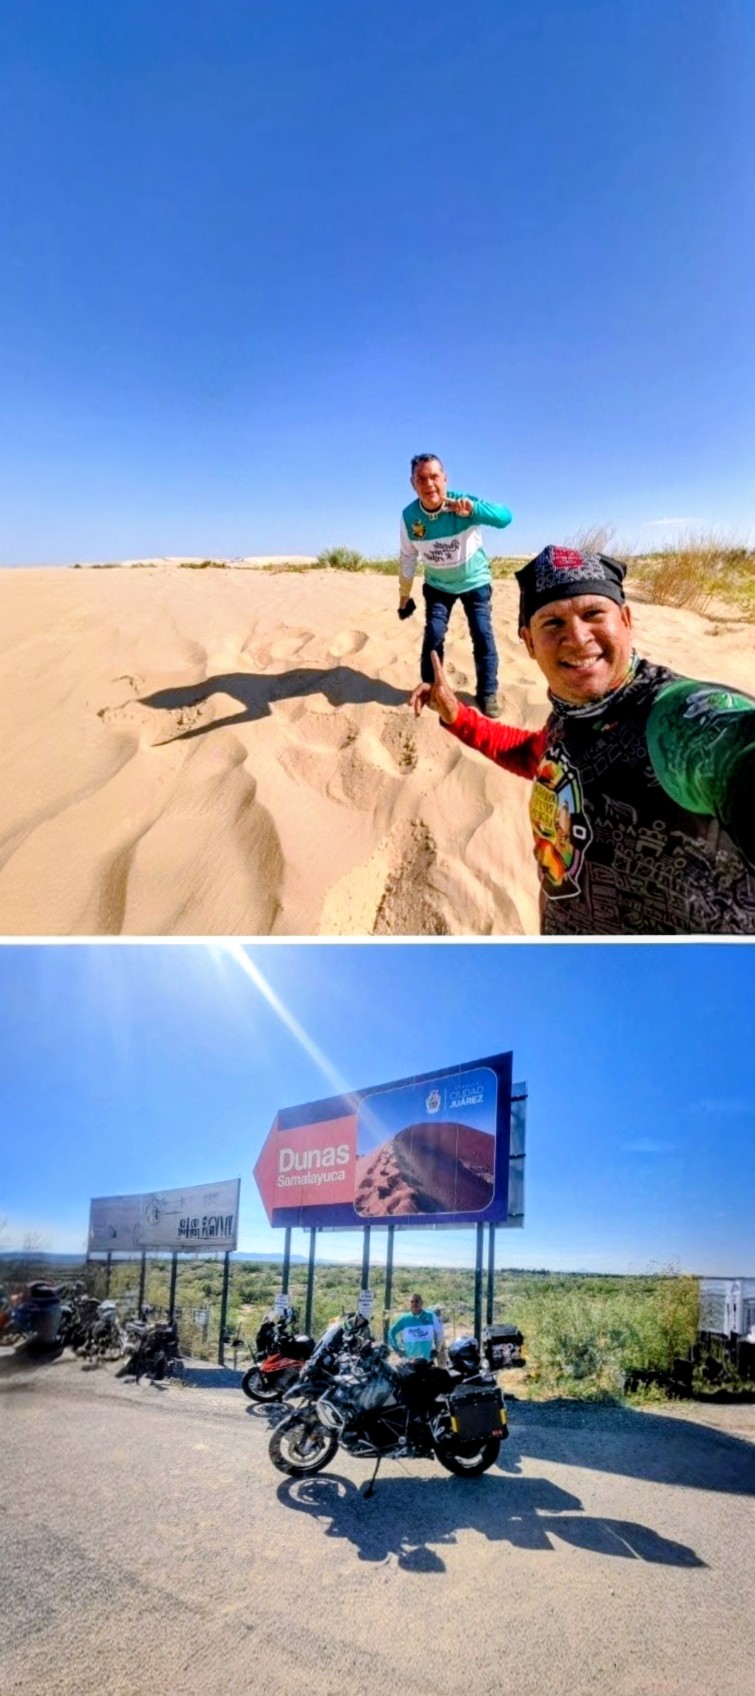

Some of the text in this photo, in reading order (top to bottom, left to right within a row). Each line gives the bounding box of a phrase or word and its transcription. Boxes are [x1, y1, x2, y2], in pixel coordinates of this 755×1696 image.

[450, 1085, 484, 1100] CIUDAD
[279, 1144, 350, 1173] Dunas
[277, 1170, 346, 1190] Samalayuca
